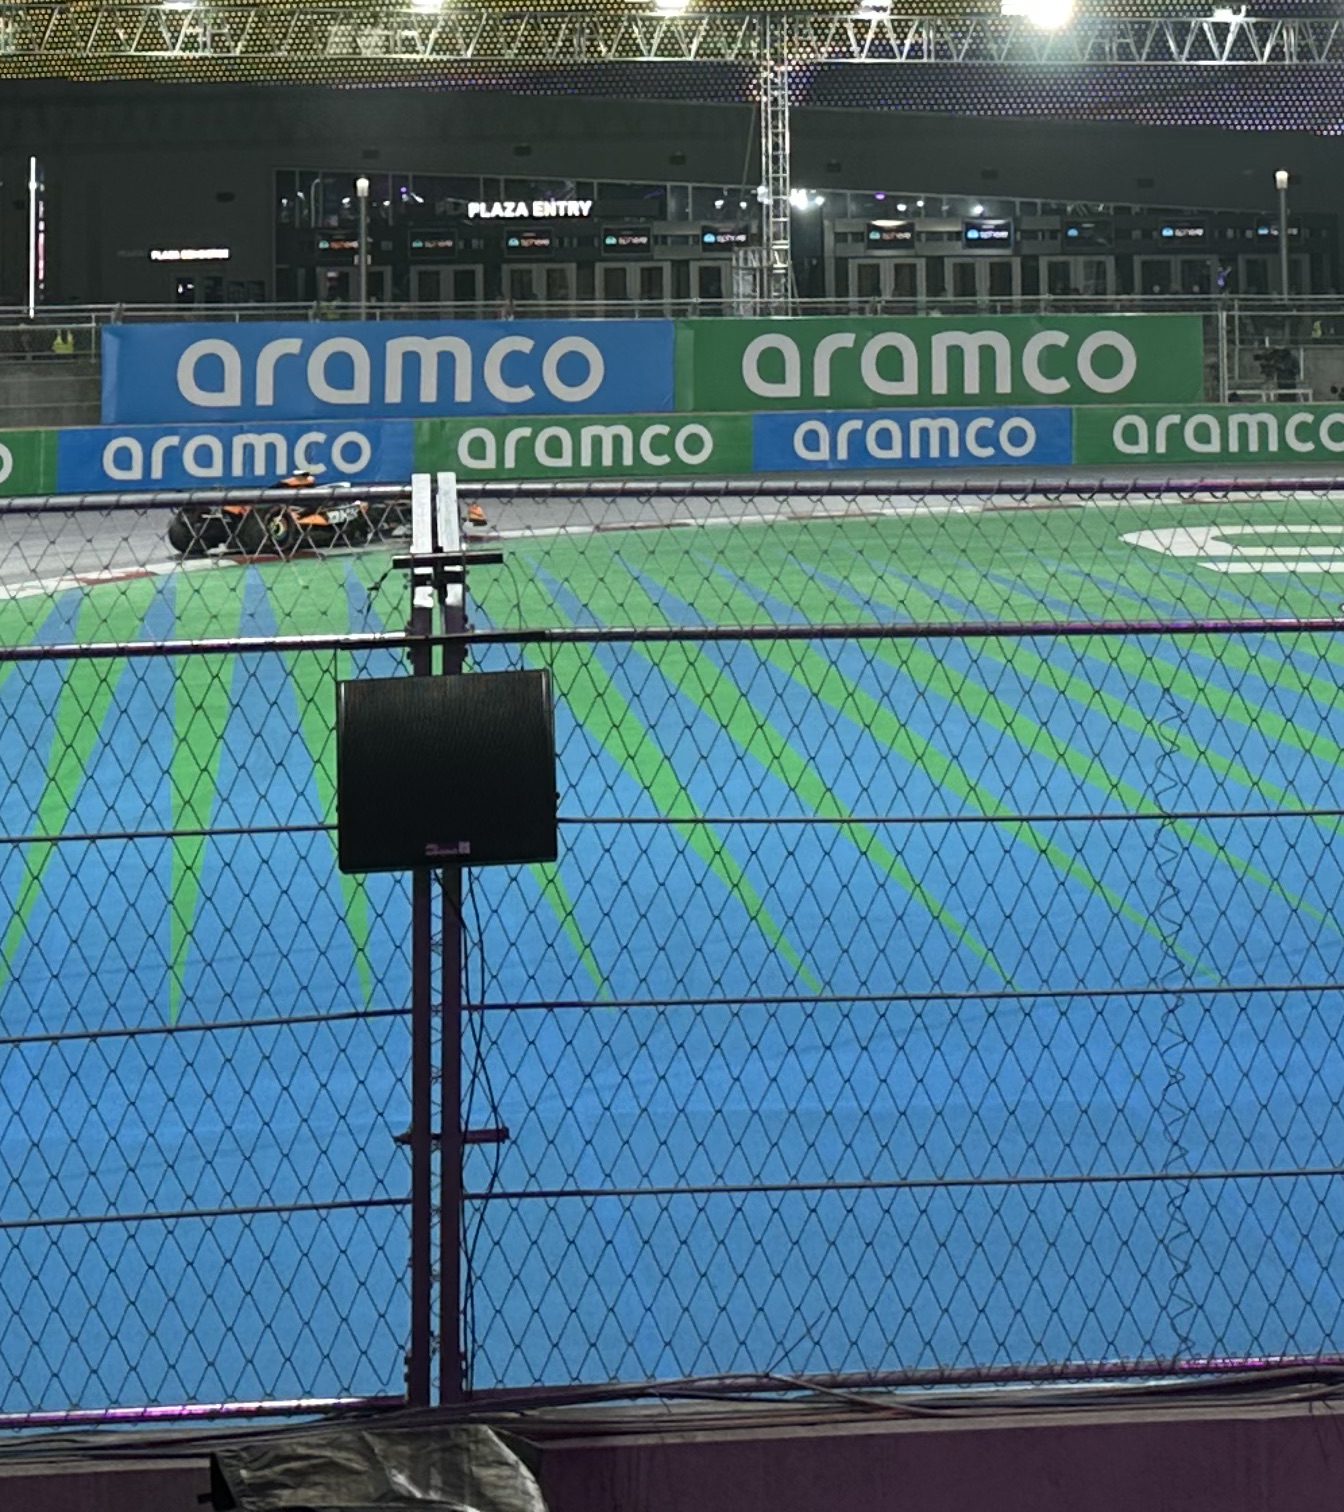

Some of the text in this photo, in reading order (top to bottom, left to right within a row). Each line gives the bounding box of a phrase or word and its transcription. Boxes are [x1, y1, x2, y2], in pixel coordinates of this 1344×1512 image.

[467, 199, 593, 219] PLAZA ENTRY
[177, 335, 605, 407] aramco
[741, 329, 1138, 398] aramco
[102, 430, 371, 481] aramco
[457, 423, 714, 470] aramco
[793, 416, 1036, 461] aramco
